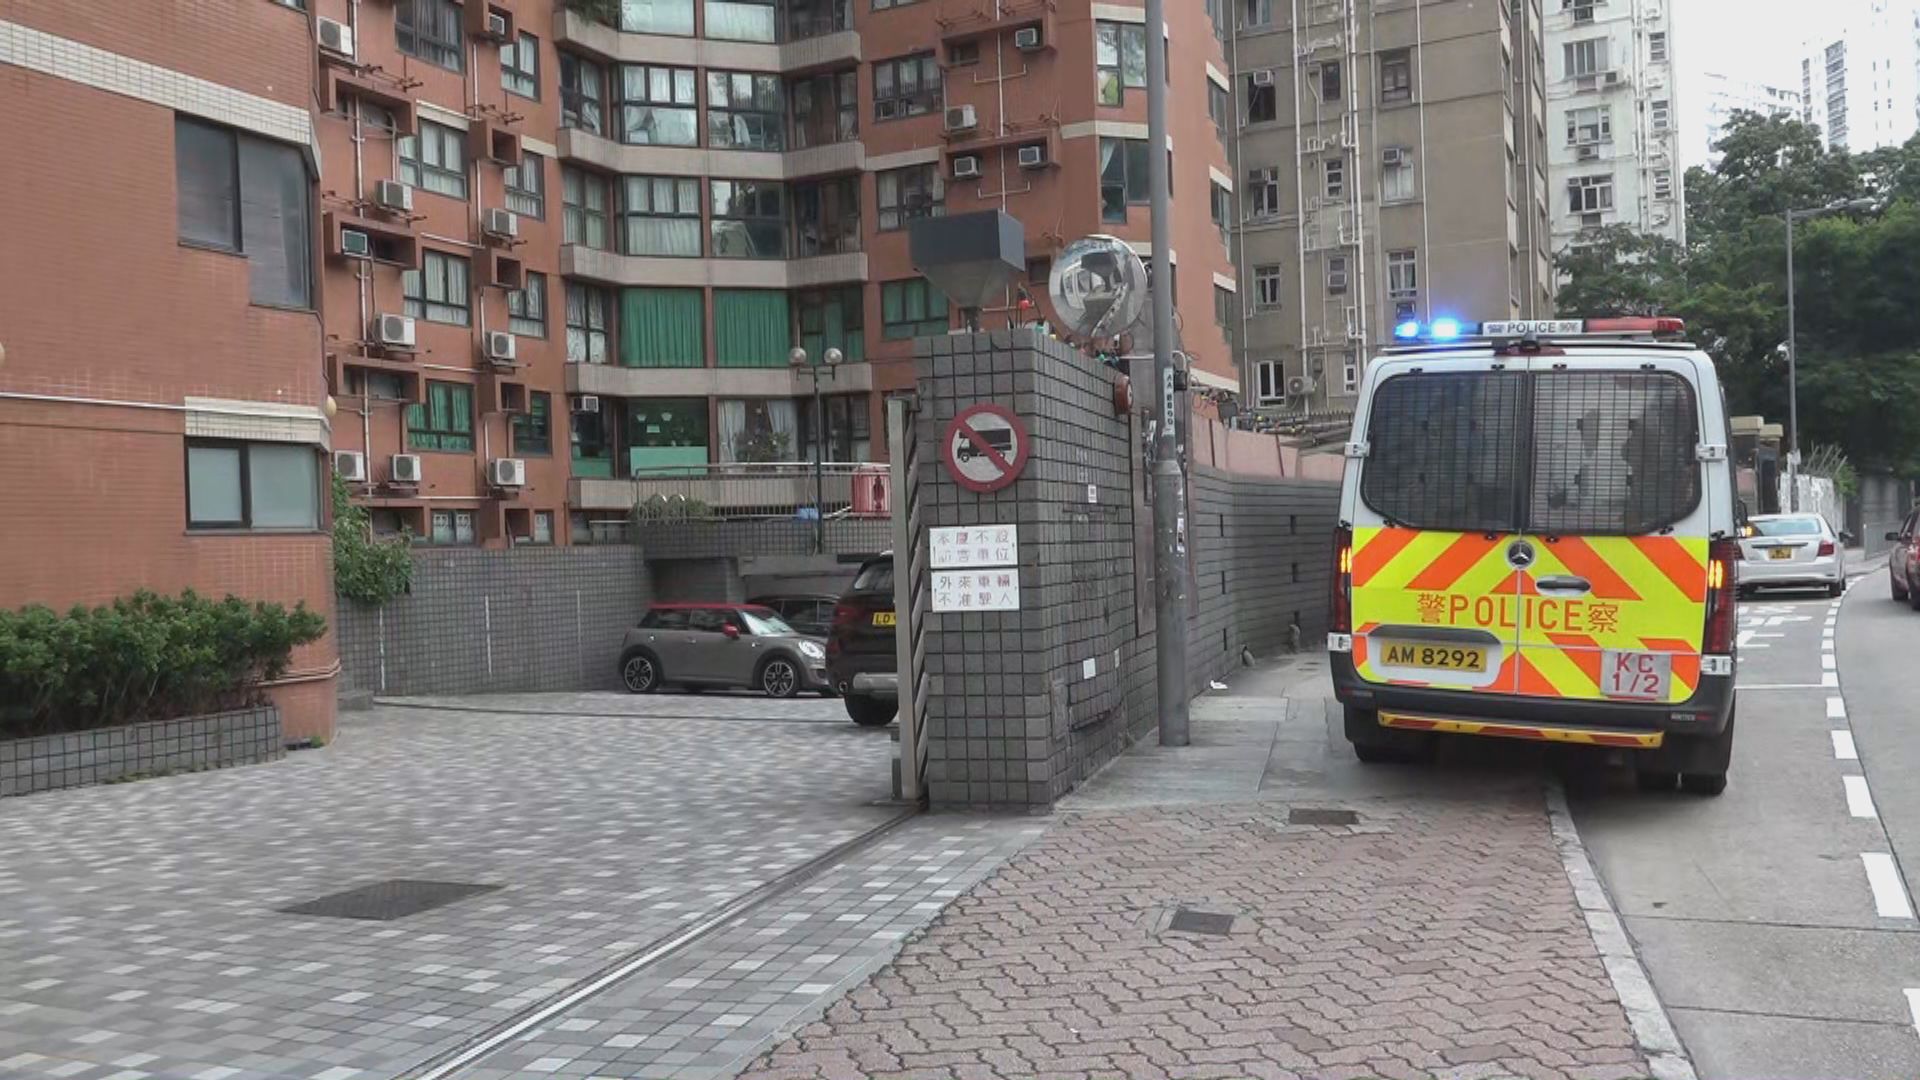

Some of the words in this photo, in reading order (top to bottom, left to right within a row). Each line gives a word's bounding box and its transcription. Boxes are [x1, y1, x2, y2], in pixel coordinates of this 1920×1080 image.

[1507, 322, 1556, 334] POLICE
[1386, 646, 1415, 665] AM
[1421, 647, 1480, 669] 8292
